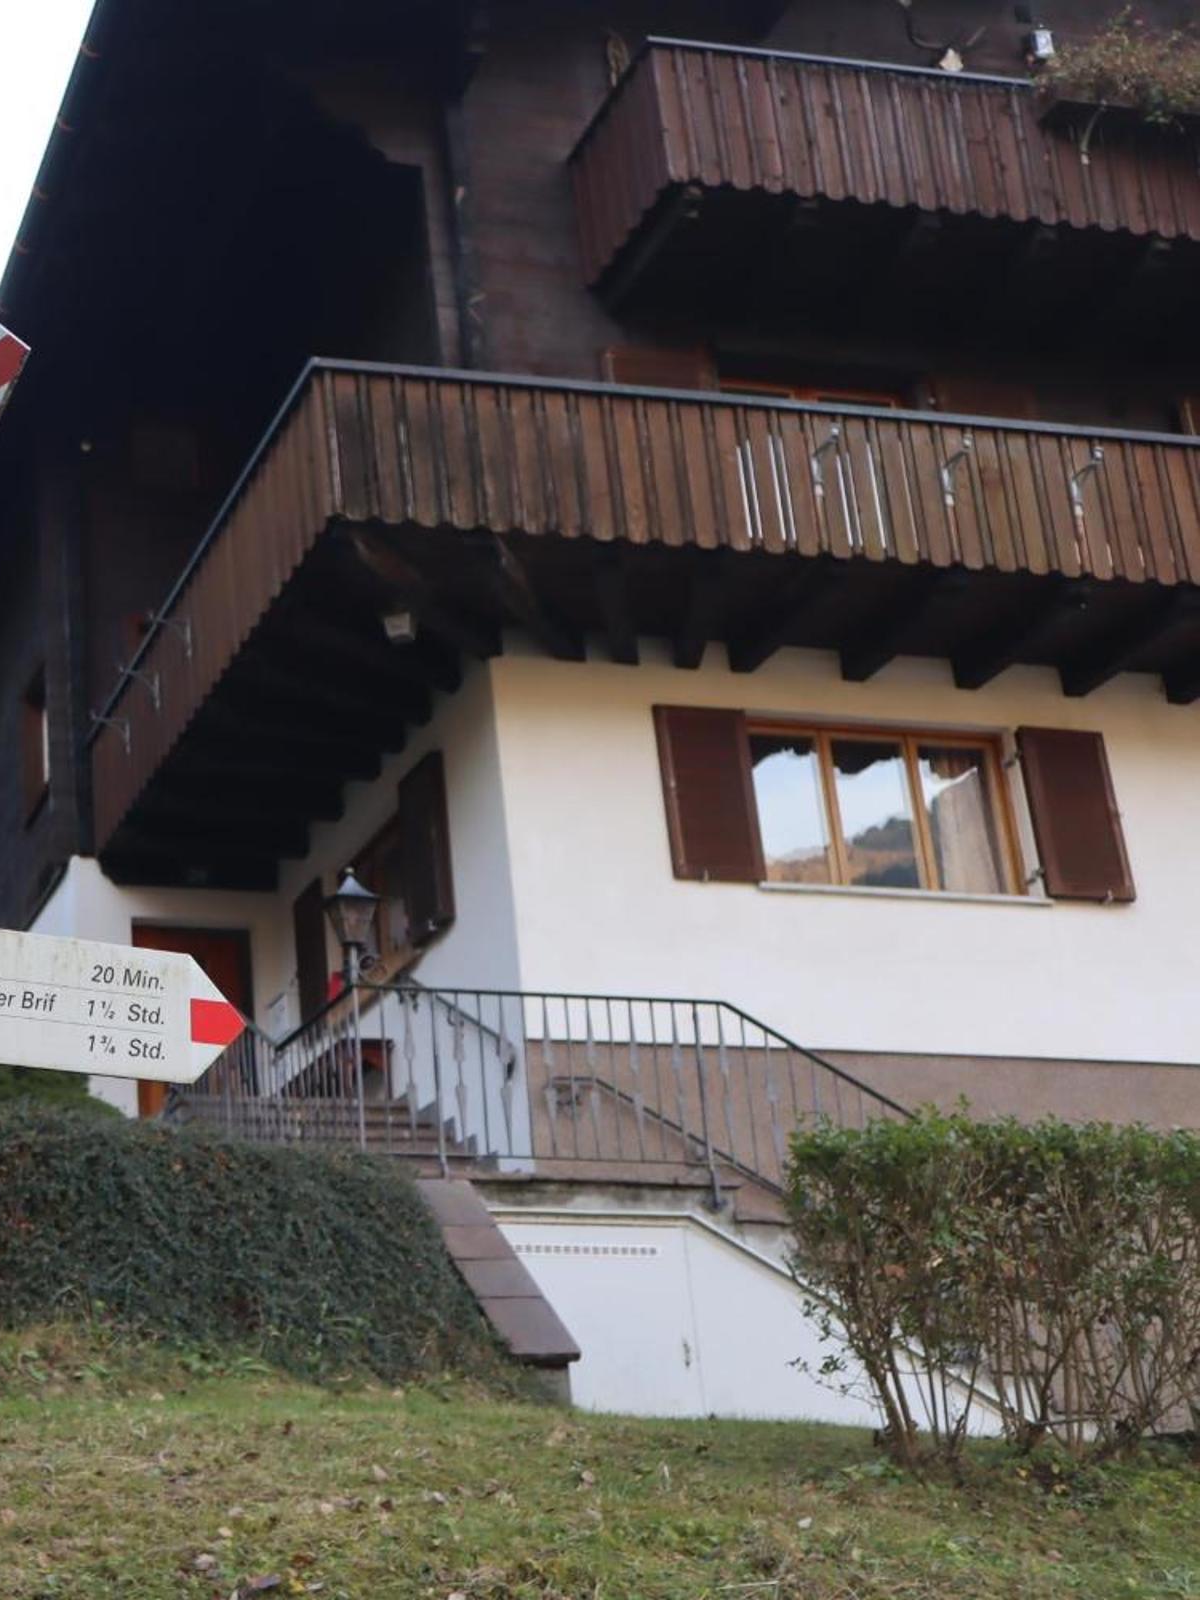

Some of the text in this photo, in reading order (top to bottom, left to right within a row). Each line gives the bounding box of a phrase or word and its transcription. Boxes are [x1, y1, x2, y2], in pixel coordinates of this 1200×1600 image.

[91, 964, 115, 984] 20
[122, 968, 164, 990] Min.
[21, 991, 57, 1012] Brif
[127, 1003, 164, 1025] Std.
[128, 1038, 165, 1060] Std.
